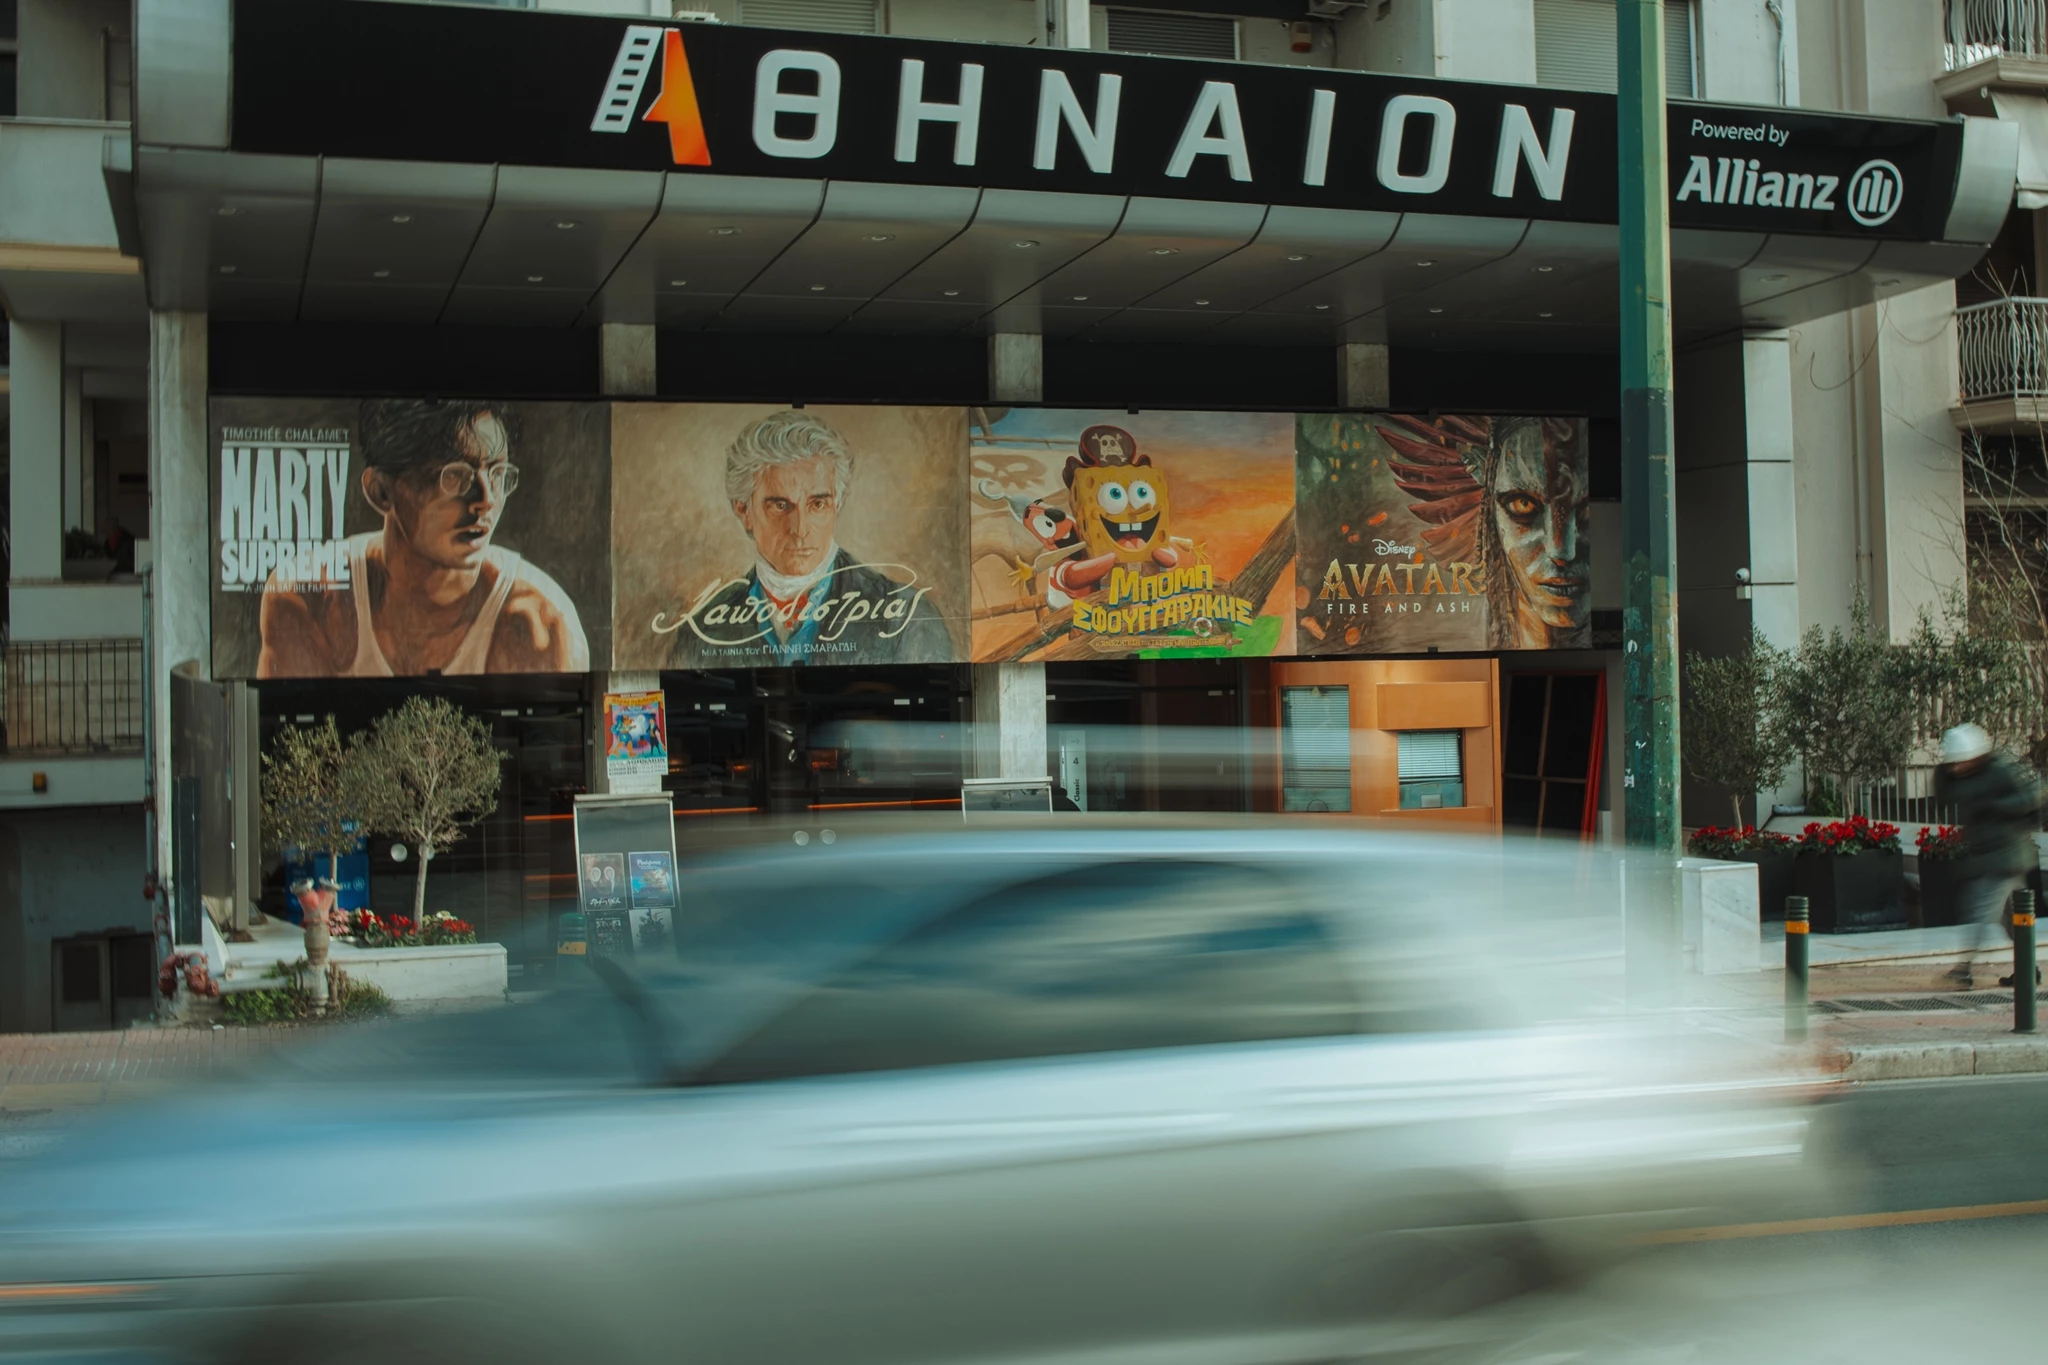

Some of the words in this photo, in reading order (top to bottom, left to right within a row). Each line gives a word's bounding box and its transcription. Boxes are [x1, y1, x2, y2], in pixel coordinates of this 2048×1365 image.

[591, 25, 1576, 201] ΑΘΗΝΑΙΟΝ
[1690, 119, 1766, 142] Powered
[1768, 124, 1790, 147] by
[1676, 155, 1839, 211] Allianz
[222, 426, 280, 440] TIMOTHÉE
[285, 428, 349, 442] CHALAMET
[221, 448, 350, 540] MARTY
[221, 540, 350, 584] SUPREME
[1317, 558, 1479, 600] AVATAR
[1109, 564, 1213, 608] ΜΠΟΜΠ
[1072, 594, 1252, 635] ΣΦΟΥΓΓΑΡΑΚΗΣ
[1327, 603, 1369, 614] FIRE
[1385, 602, 1422, 613] AND
[1436, 601, 1470, 613] ASH
[719, 648, 744, 656] ΤΑΙΝΙΑ
[745, 647, 760, 656] ΤΟΥ
[762, 644, 800, 654] ΓΙΑΝΝΗ
[803, 642, 857, 653] ΣΜΑΡΑΓΔΗ
